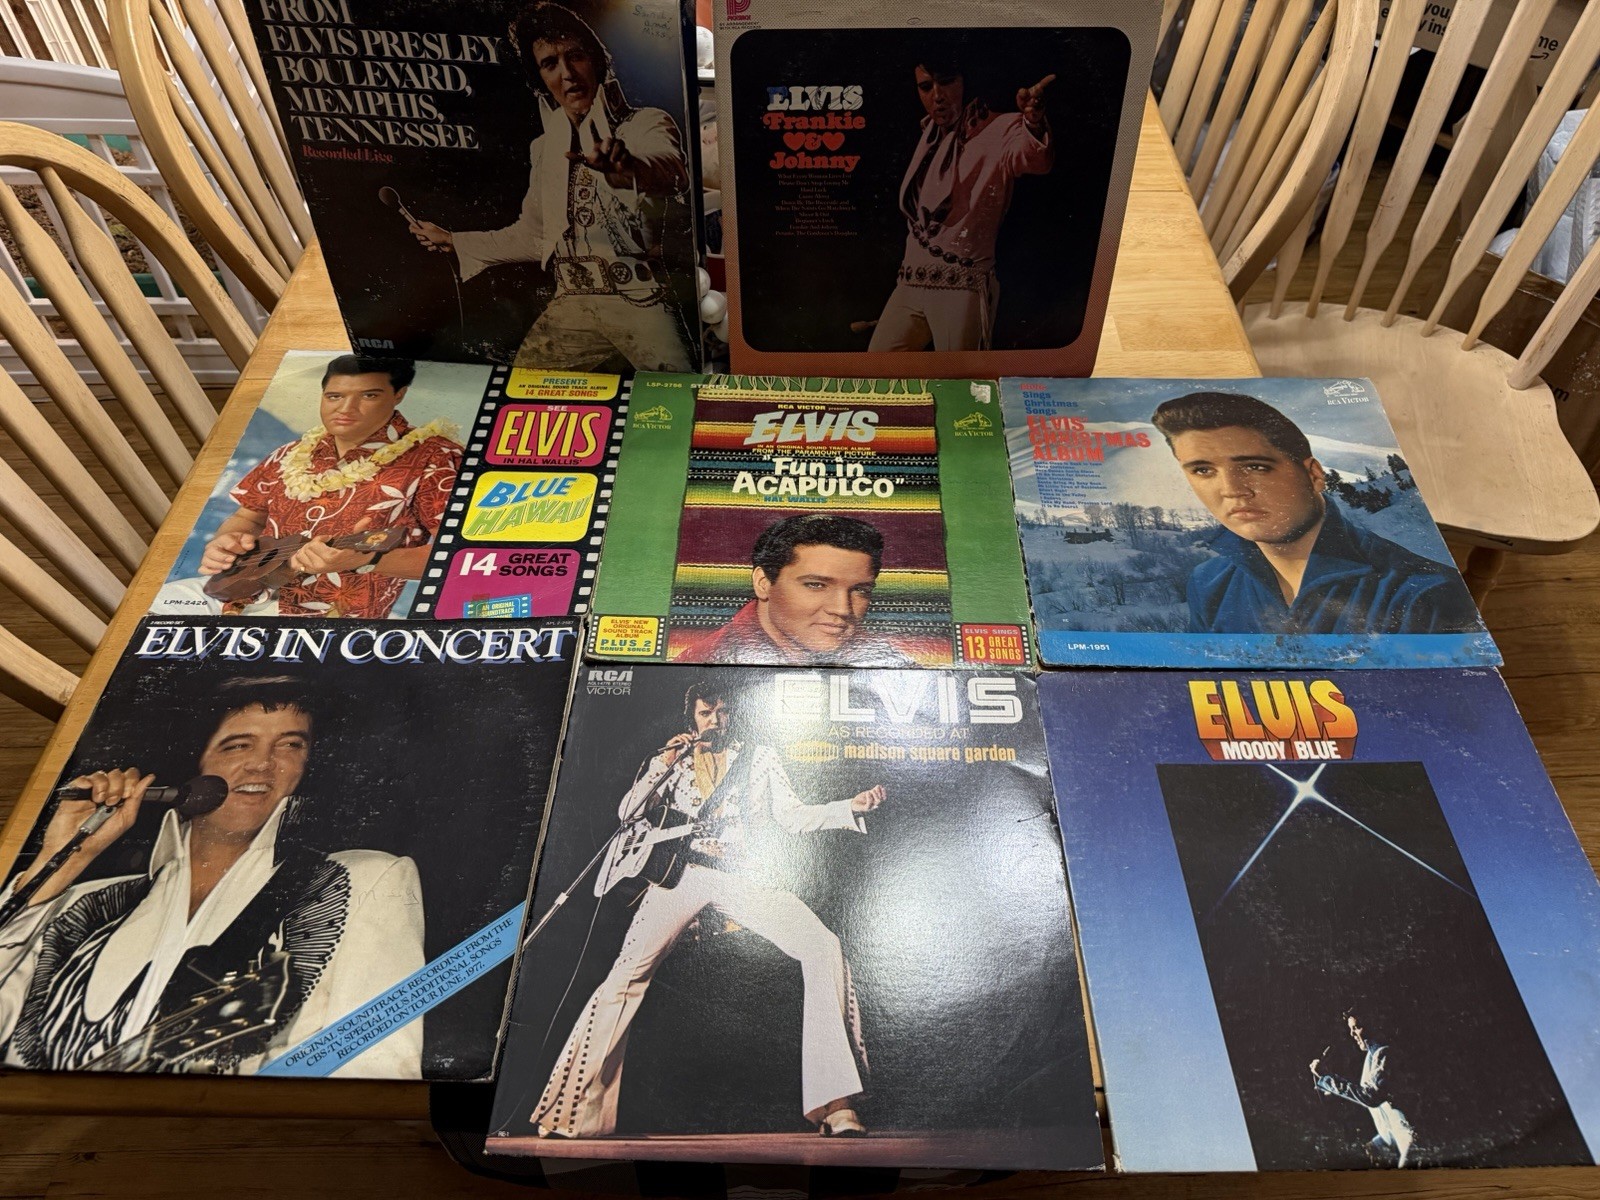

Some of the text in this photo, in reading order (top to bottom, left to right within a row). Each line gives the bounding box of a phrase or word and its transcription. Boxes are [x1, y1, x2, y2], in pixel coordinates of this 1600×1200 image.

[260, 0, 354, 25] FROM
[265, 25, 502, 64] ELVIS PRESLEY
[274, 56, 472, 97] BOULEVARD,
[283, 86, 444, 124] MEMPHIS,
[766, 85, 864, 111] ELVIS
[763, 112, 866, 130] Frankie
[290, 115, 479, 149] TENNESSEE
[804, 132, 822, 151] &
[302, 145, 393, 163] Recorded Live
[769, 151, 861, 173] Johnny
[358, 338, 395, 349] RCA
[537, 389, 566, 397] GREAT
[568, 390, 599, 398] SONGS
[1022, 391, 1052, 400] Sings
[1341, 396, 1369, 404] VICTOR
[1024, 399, 1079, 408] Christmas
[1025, 407, 1058, 416] Songs
[495, 410, 602, 459] ELVIS
[743, 410, 880, 446] ELVIS
[1028, 431, 1151, 448] CHRISTMAS
[1033, 445, 1104, 462] ALBUM
[835, 457, 864, 477] in
[476, 477, 577, 508] BLUE
[464, 493, 593, 536] HAWAII
[459, 552, 497, 576] 14
[508, 553, 572, 564] GREAT
[498, 565, 569, 577] SONGS
[491, 601, 515, 609] ORIGINAL
[134, 626, 576, 664] ELVIS IN CONCERT
[965, 635, 986, 660] 13
[988, 636, 1018, 648] GREAT
[1067, 643, 1110, 651] LPM-1951
[988, 648, 1021, 660] SONGS
[588, 670, 634, 681] RCA
[586, 687, 631, 695] VICTOR
[775, 674, 1023, 724] ELVIS
[828, 726, 970, 739] AS RECORDED AT
[844, 742, 1016, 763] madison square garden
[1220, 741, 1341, 760] MOODY BLUE
[285, 918, 514, 1067] ORIGINAL SOUNDTRACK RECORDING FROM THE
[306, 937, 503, 1067] CBS-TV SPECIAL PLUS ADDITIONAL SONGS
[336, 1020, 394, 1060] RECORDED
[392, 1009, 411, 1024] ON
[407, 991, 439, 1014] TOUR
[438, 973, 467, 997] JUNE,
